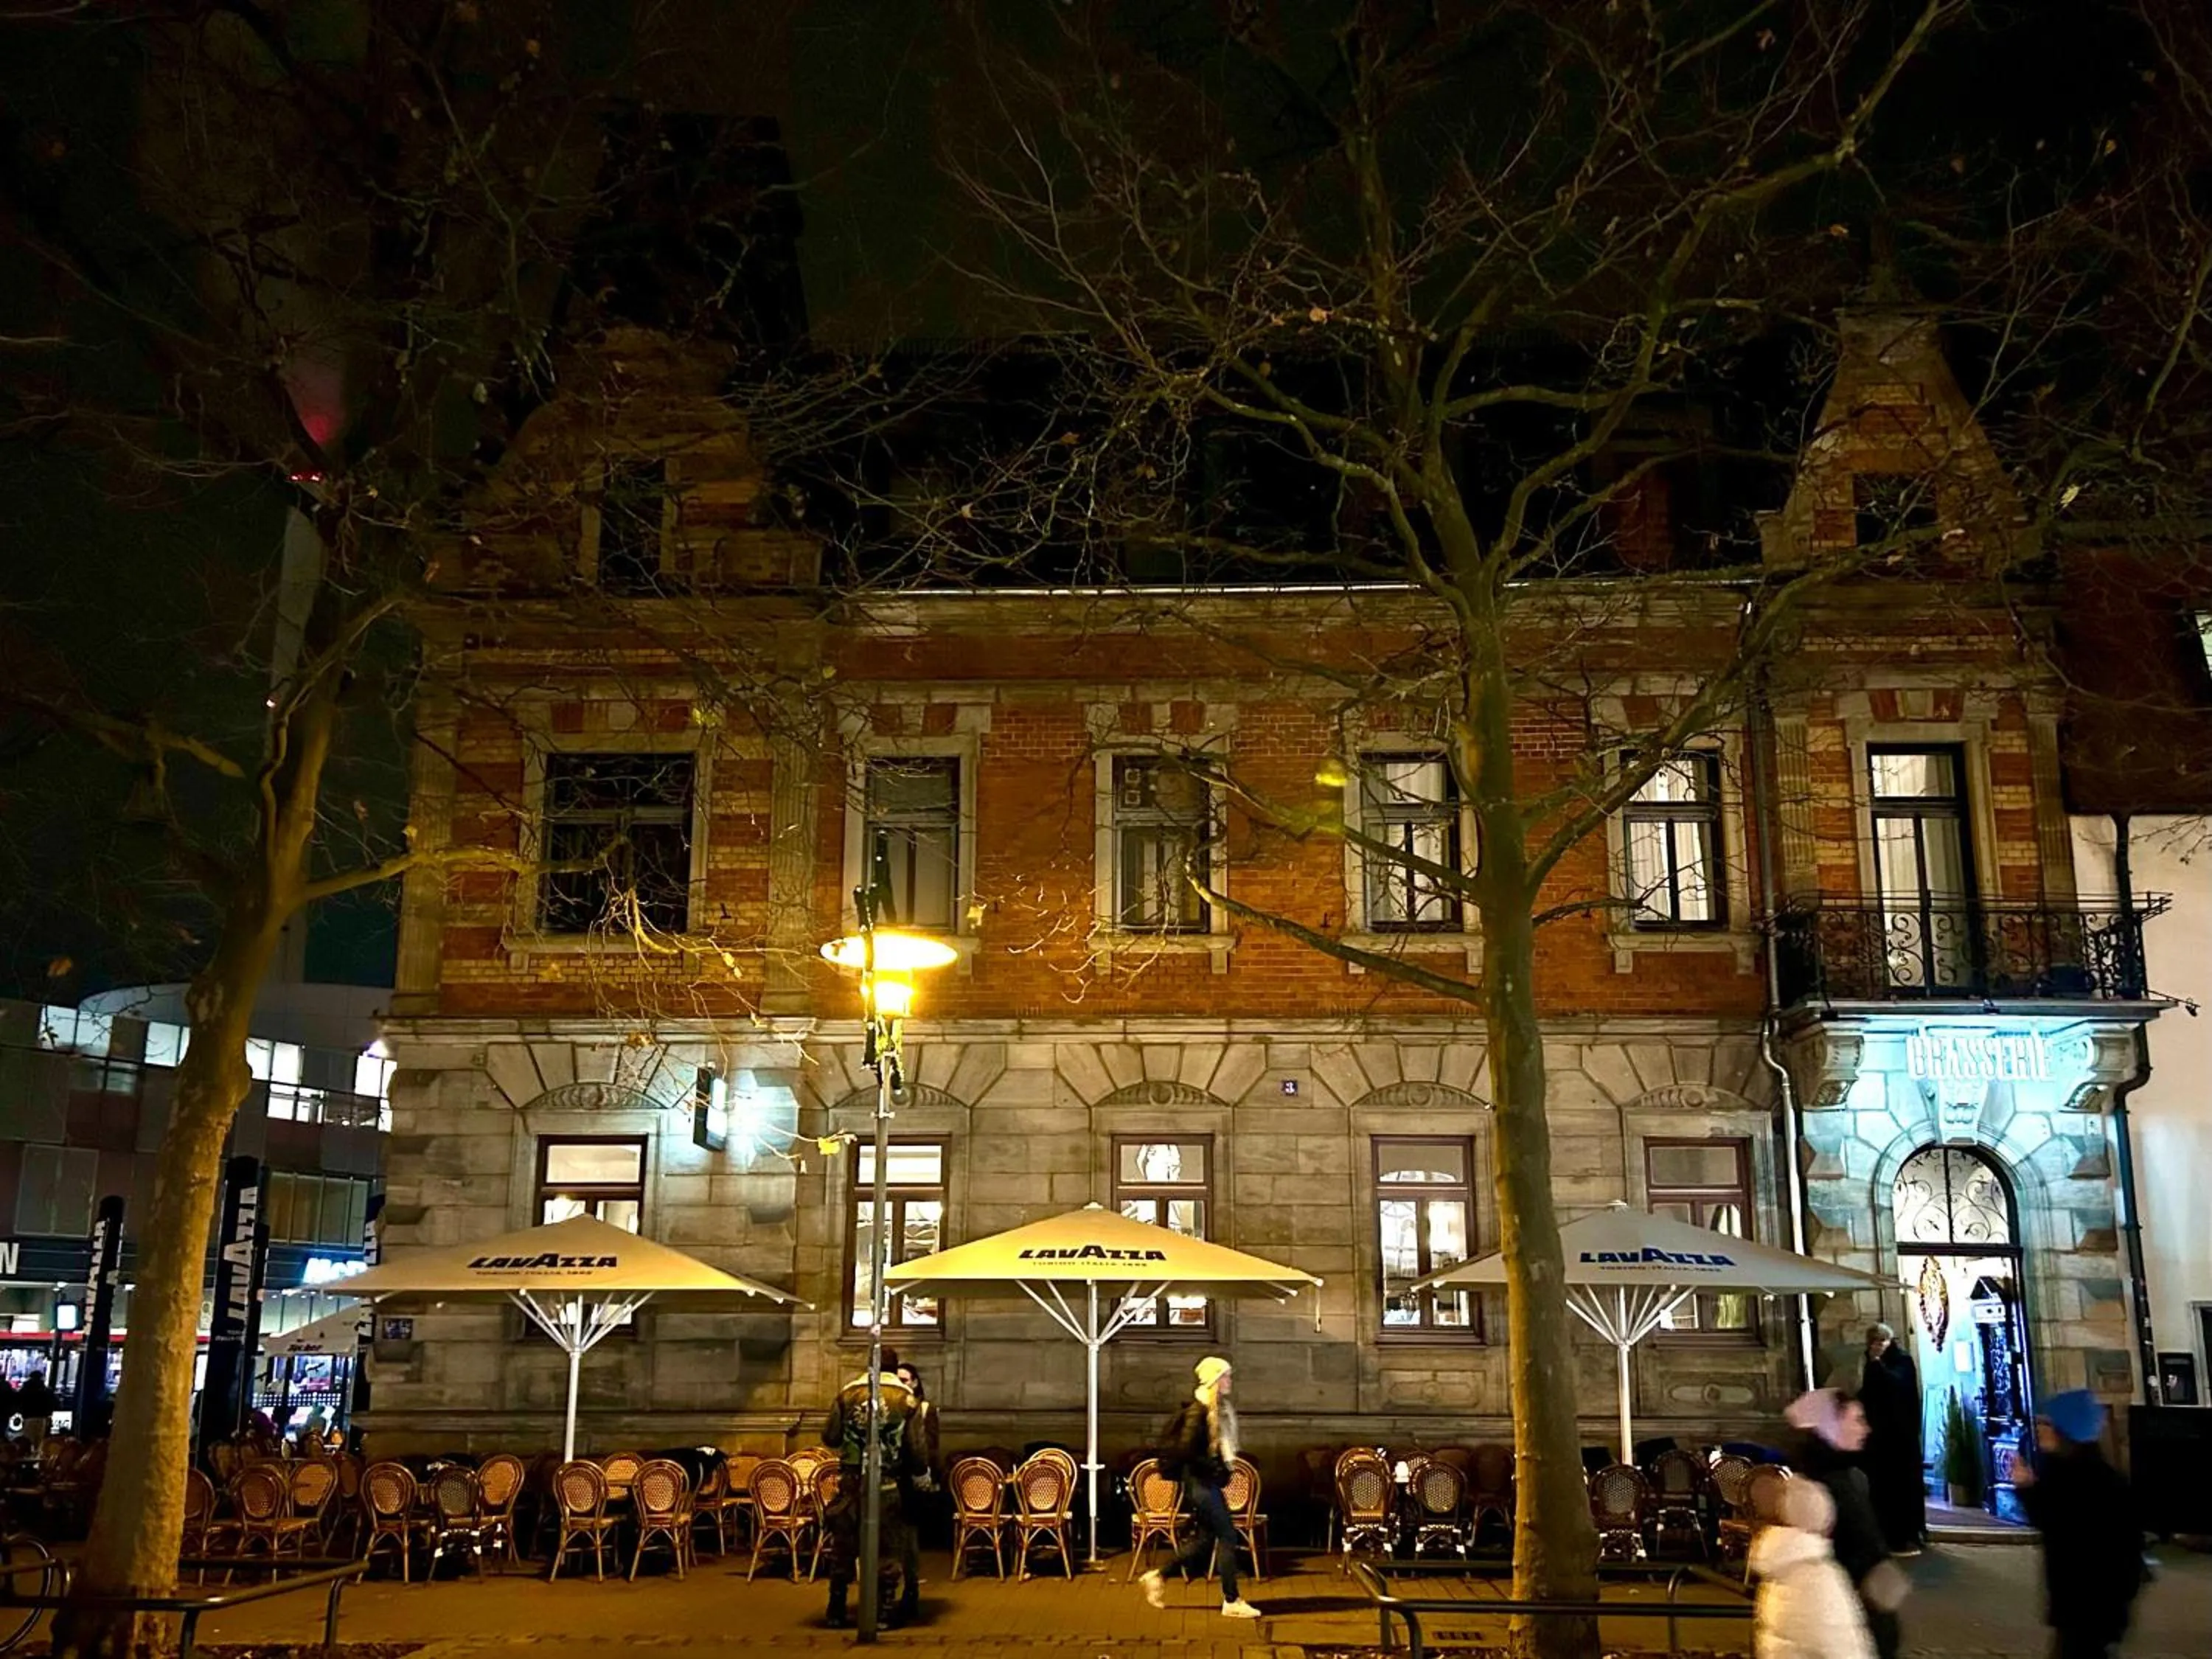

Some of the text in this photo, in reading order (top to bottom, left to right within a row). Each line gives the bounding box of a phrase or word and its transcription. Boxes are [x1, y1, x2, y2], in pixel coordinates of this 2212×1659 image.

[1906, 1037, 2056, 1082] BRASSERIE
[223, 1186, 258, 1321] LAVAZZA
[467, 1253, 618, 1269] LAVAZZA
[1018, 1245, 1167, 1262] LAVAZZA
[1579, 1247, 1737, 1267] LAVAZZA
